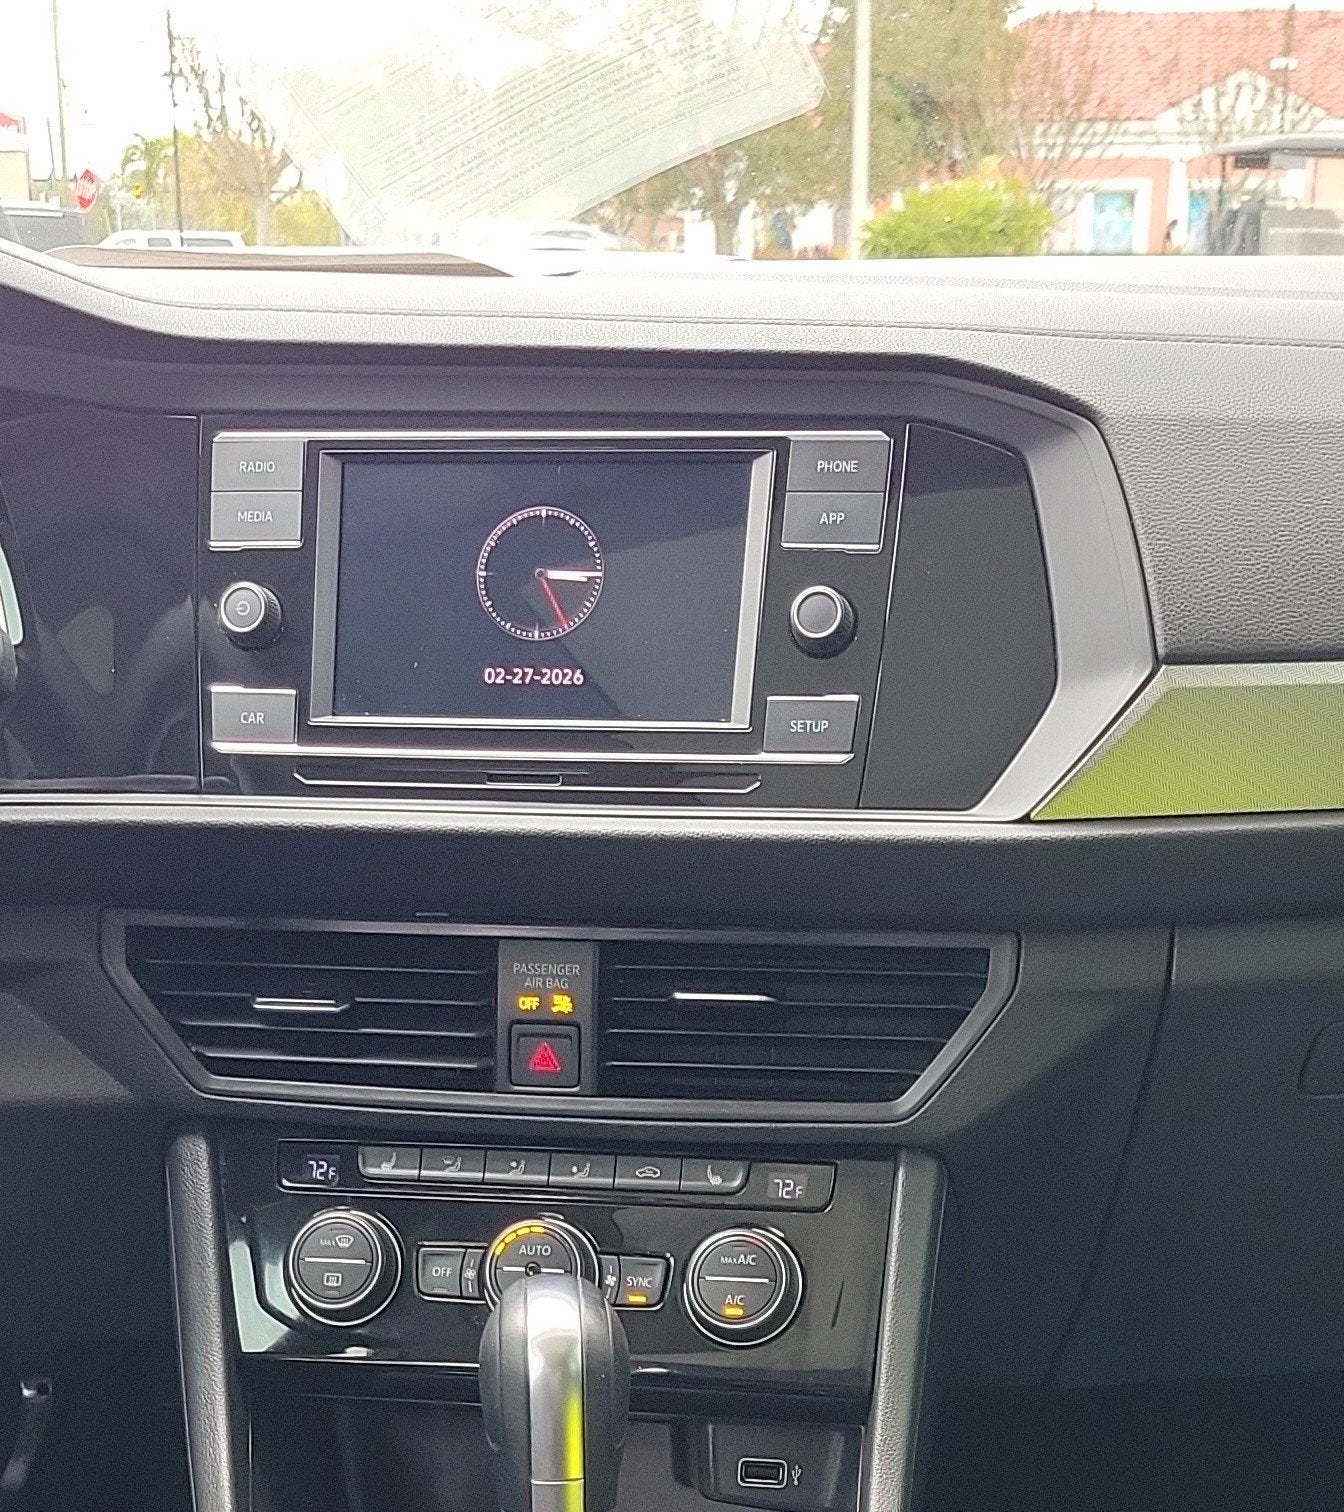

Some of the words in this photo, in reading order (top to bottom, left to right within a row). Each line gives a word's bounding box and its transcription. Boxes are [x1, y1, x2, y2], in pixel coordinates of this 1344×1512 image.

[239, 461, 276, 473] RADIO
[816, 460, 859, 473] PHONE
[237, 510, 274, 523] MEDIA
[819, 512, 846, 526] APP
[483, 667, 585, 687] 02-27-2026
[240, 712, 265, 725] CAR
[789, 719, 829, 734] SETUP
[513, 962, 581, 976] PASSENGER
[524, 977, 544, 989] AIR
[546, 978, 570, 990] BAG
[519, 996, 540, 1010] OFF
[518, 1244, 552, 1256] AUTO
[432, 1266, 453, 1278] OFF
[626, 1276, 653, 1289] SYNC
[724, 1294, 746, 1305] A/C
